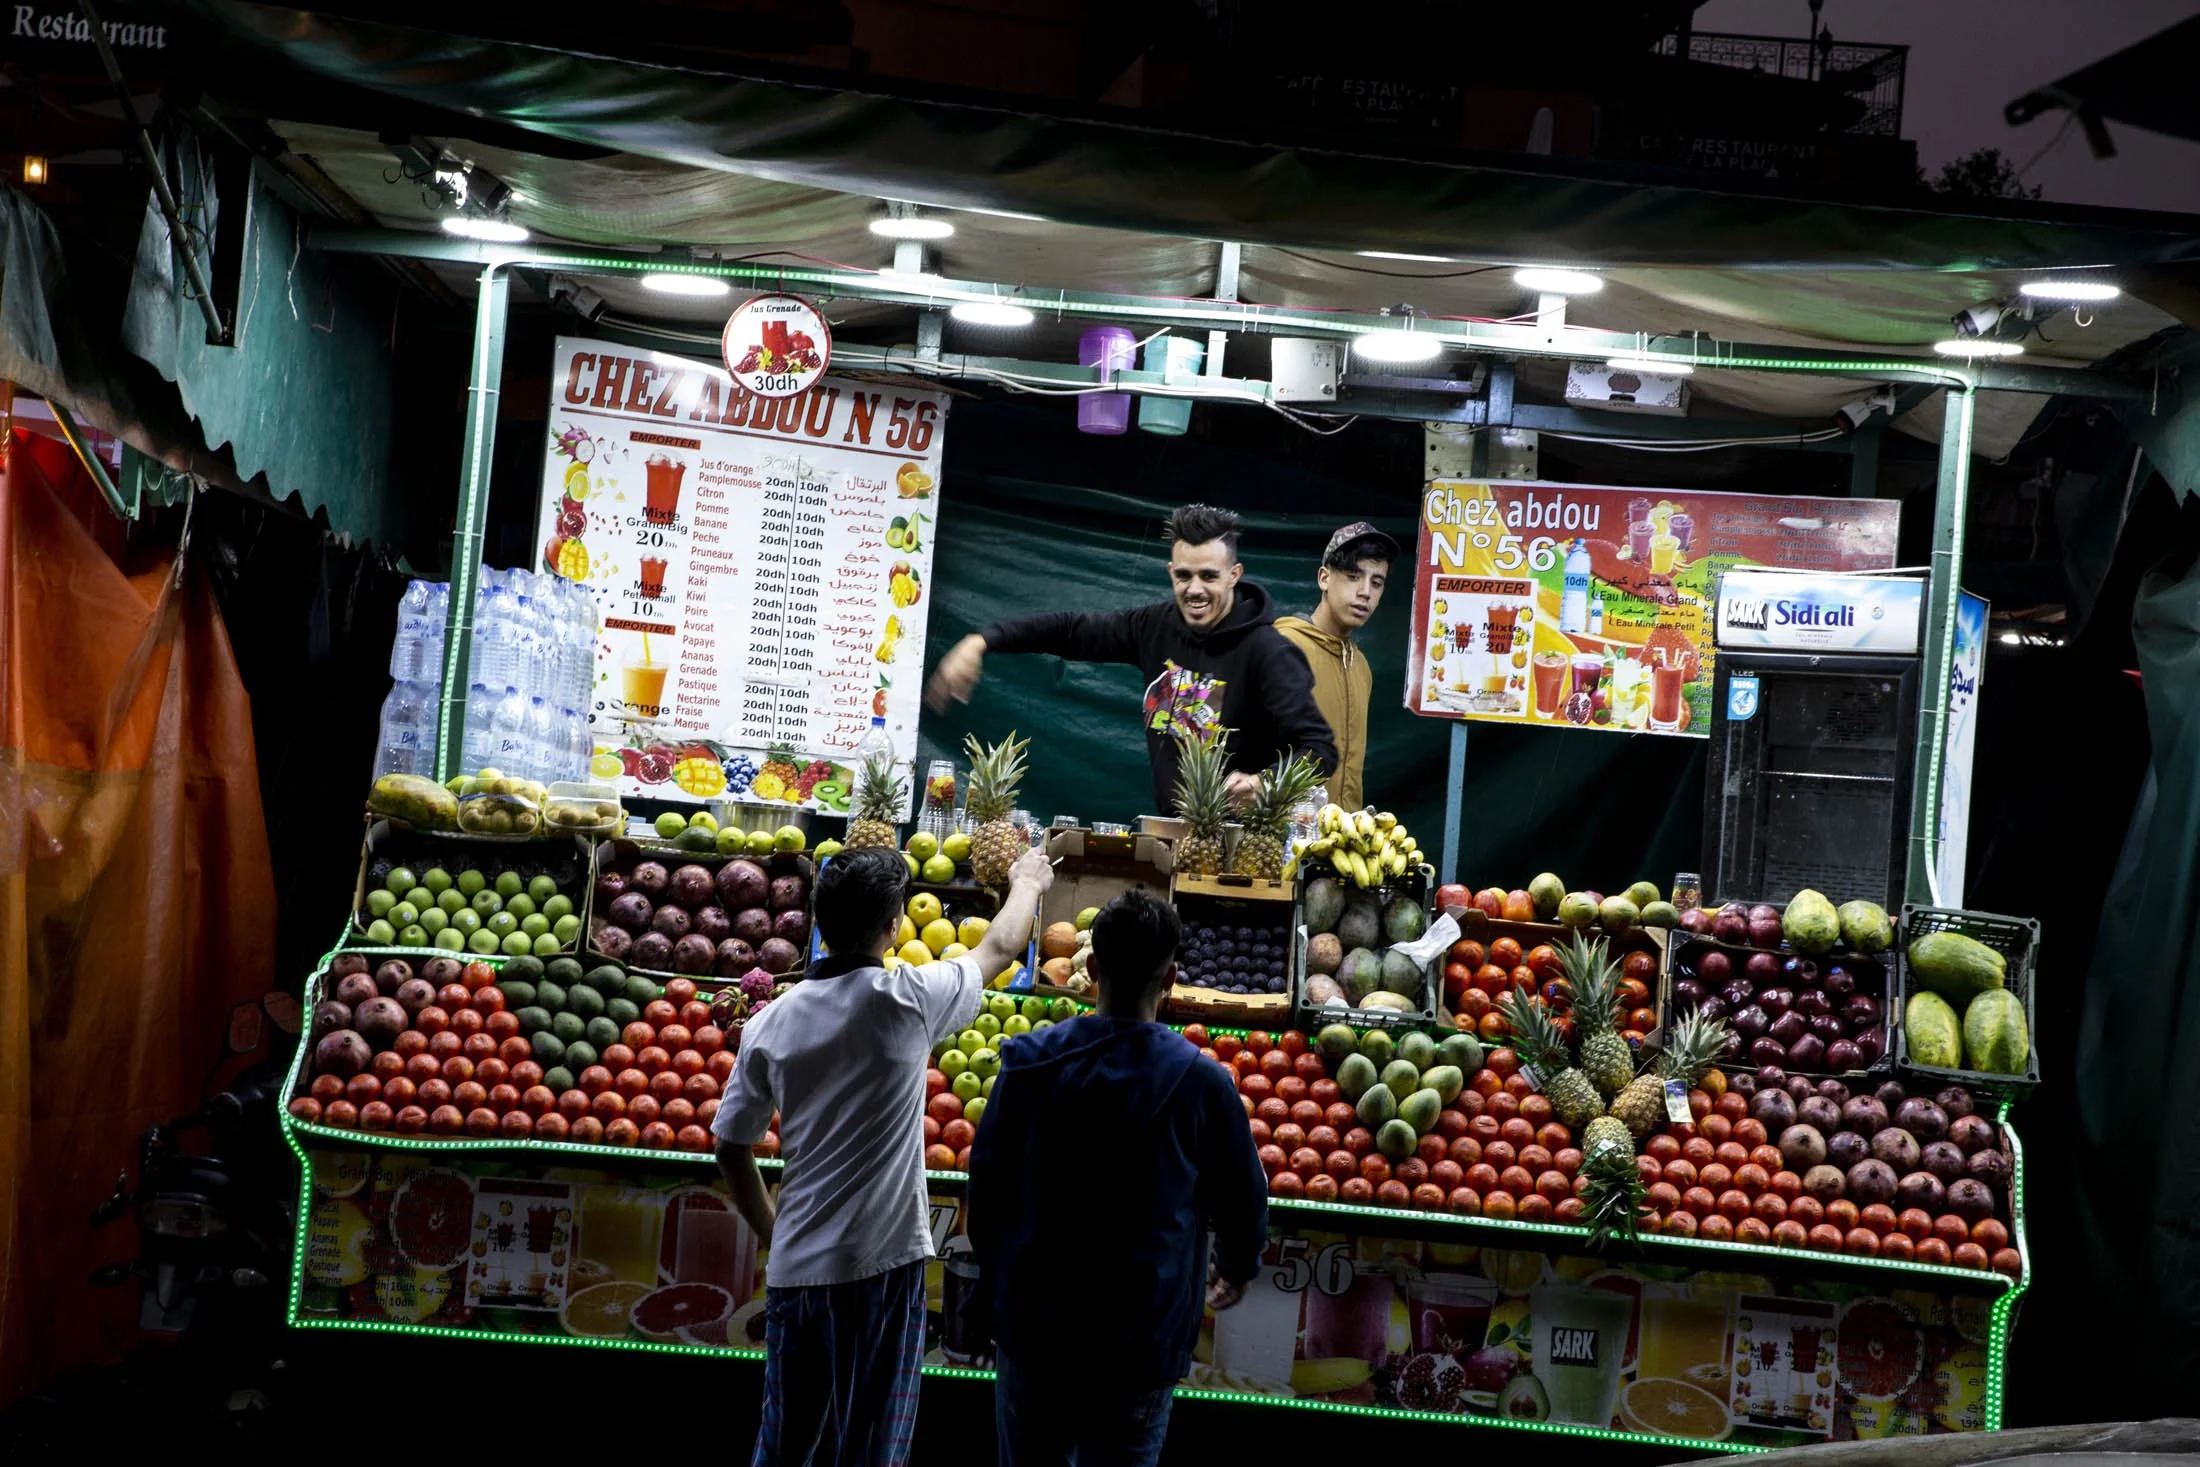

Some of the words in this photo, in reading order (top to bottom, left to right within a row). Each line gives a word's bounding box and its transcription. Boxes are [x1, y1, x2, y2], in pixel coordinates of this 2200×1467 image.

[750, 304, 765, 314] Jus
[766, 303, 802, 314] Grenade
[754, 375, 799, 392] 30dh
[565, 351, 686, 418] CHEZ
[689, 373, 841, 437] ABDOU
[843, 392, 880, 445] N
[886, 398, 940, 451] 56
[630, 431, 697, 448] EMPORTER
[700, 458, 714, 470] Jus
[716, 461, 754, 476] d'orange
[699, 471, 762, 489] Pamplemousse
[765, 476, 795, 489] 20dh
[799, 481, 829, 493] 10dh
[846, 475, 887, 493] البرتقال
[697, 486, 725, 499] Citron
[764, 490, 793, 502] 20dh
[798, 495, 828, 507] 10dh
[641, 506, 681, 522] Mixte
[695, 501, 729, 515] Pomme
[762, 507, 792, 519] 20dh
[796, 512, 826, 524] 10dh
[830, 507, 885, 519] حامض
[1425, 488, 1498, 526] Chez
[1505, 491, 1601, 531] abdou
[626, 516, 688, 535] Grand/Big
[694, 516, 728, 530] Banane
[761, 521, 790, 533] 20dh
[795, 526, 824, 537] 10dh
[847, 523, 884, 534] تفاح
[635, 529, 664, 547] 20
[692, 531, 720, 544] Peche
[759, 535, 788, 546] 20dh
[793, 539, 823, 551] 10dh
[857, 537, 882, 549] موز
[691, 546, 734, 560] Pruneaux
[844, 551, 881, 563] خوخ
[1429, 530, 1557, 572] N°56
[757, 551, 787, 563] 20dh
[791, 556, 822, 568] 10dh
[689, 560, 739, 576] Gingembre
[836, 566, 879, 580] برقوق
[687, 575, 708, 587] Kaki
[755, 568, 785, 580] 20dh
[790, 572, 820, 584] 10dh
[1564, 575, 1588, 587] 10dh
[1603, 576, 1629, 588] كبير
[1676, 578, 1698, 589] ماء
[633, 580, 668, 593] Mixte
[754, 582, 784, 593] 20dh
[789, 586, 819, 597] 10dh
[1436, 578, 1526, 595] EMPORTER
[686, 590, 706, 602] Kiwi
[832, 596, 877, 608] كاكي
[1600, 590, 1619, 601] Eau
[1666, 594, 1698, 607] Grand
[631, 601, 653, 616] 10
[685, 605, 708, 617] Poire
[752, 598, 783, 609] 20dh
[787, 602, 817, 613] 10dh
[1727, 599, 1768, 625] SARK
[751, 611, 781, 622] 20dh
[786, 615, 816, 626] 10dh
[1775, 600, 1820, 626] Sidi
[1824, 605, 1855, 627] ali
[605, 618, 672, 633] EMPORTER
[683, 620, 714, 632] Avocat
[823, 623, 873, 638] بوعويد
[1615, 618, 1632, 627] Eau
[1674, 621, 1695, 631] Petit
[750, 626, 780, 637] 20dh
[785, 630, 815, 641] 10dh
[682, 634, 716, 649] Papaye
[1449, 643, 1465, 655] 10
[1485, 642, 1505, 653] 20
[681, 649, 714, 663] Ananas
[749, 643, 779, 654] 20dh
[783, 647, 814, 658] 10dh
[679, 663, 718, 677] Grenade
[747, 656, 777, 668] 20dh
[782, 660, 813, 671] 10dh
[678, 678, 718, 694] Pastique
[744, 685, 774, 696] 20dh
[779, 688, 810, 699] 10dh
[832, 681, 868, 694] رمان
[677, 692, 721, 707] Nectarine
[743, 700, 773, 710] 20dh
[778, 703, 808, 714] 10dh
[675, 704, 703, 717] Fraise
[674, 717, 710, 732] Mangue
[742, 713, 772, 724] 20dh
[777, 716, 807, 728] 10dh
[834, 719, 866, 734] فريز
[741, 727, 771, 739] 20dh
[776, 731, 806, 742] 10dh
[1273, 1238, 1356, 1297] 56
[1552, 1328, 1595, 1361] SARK
